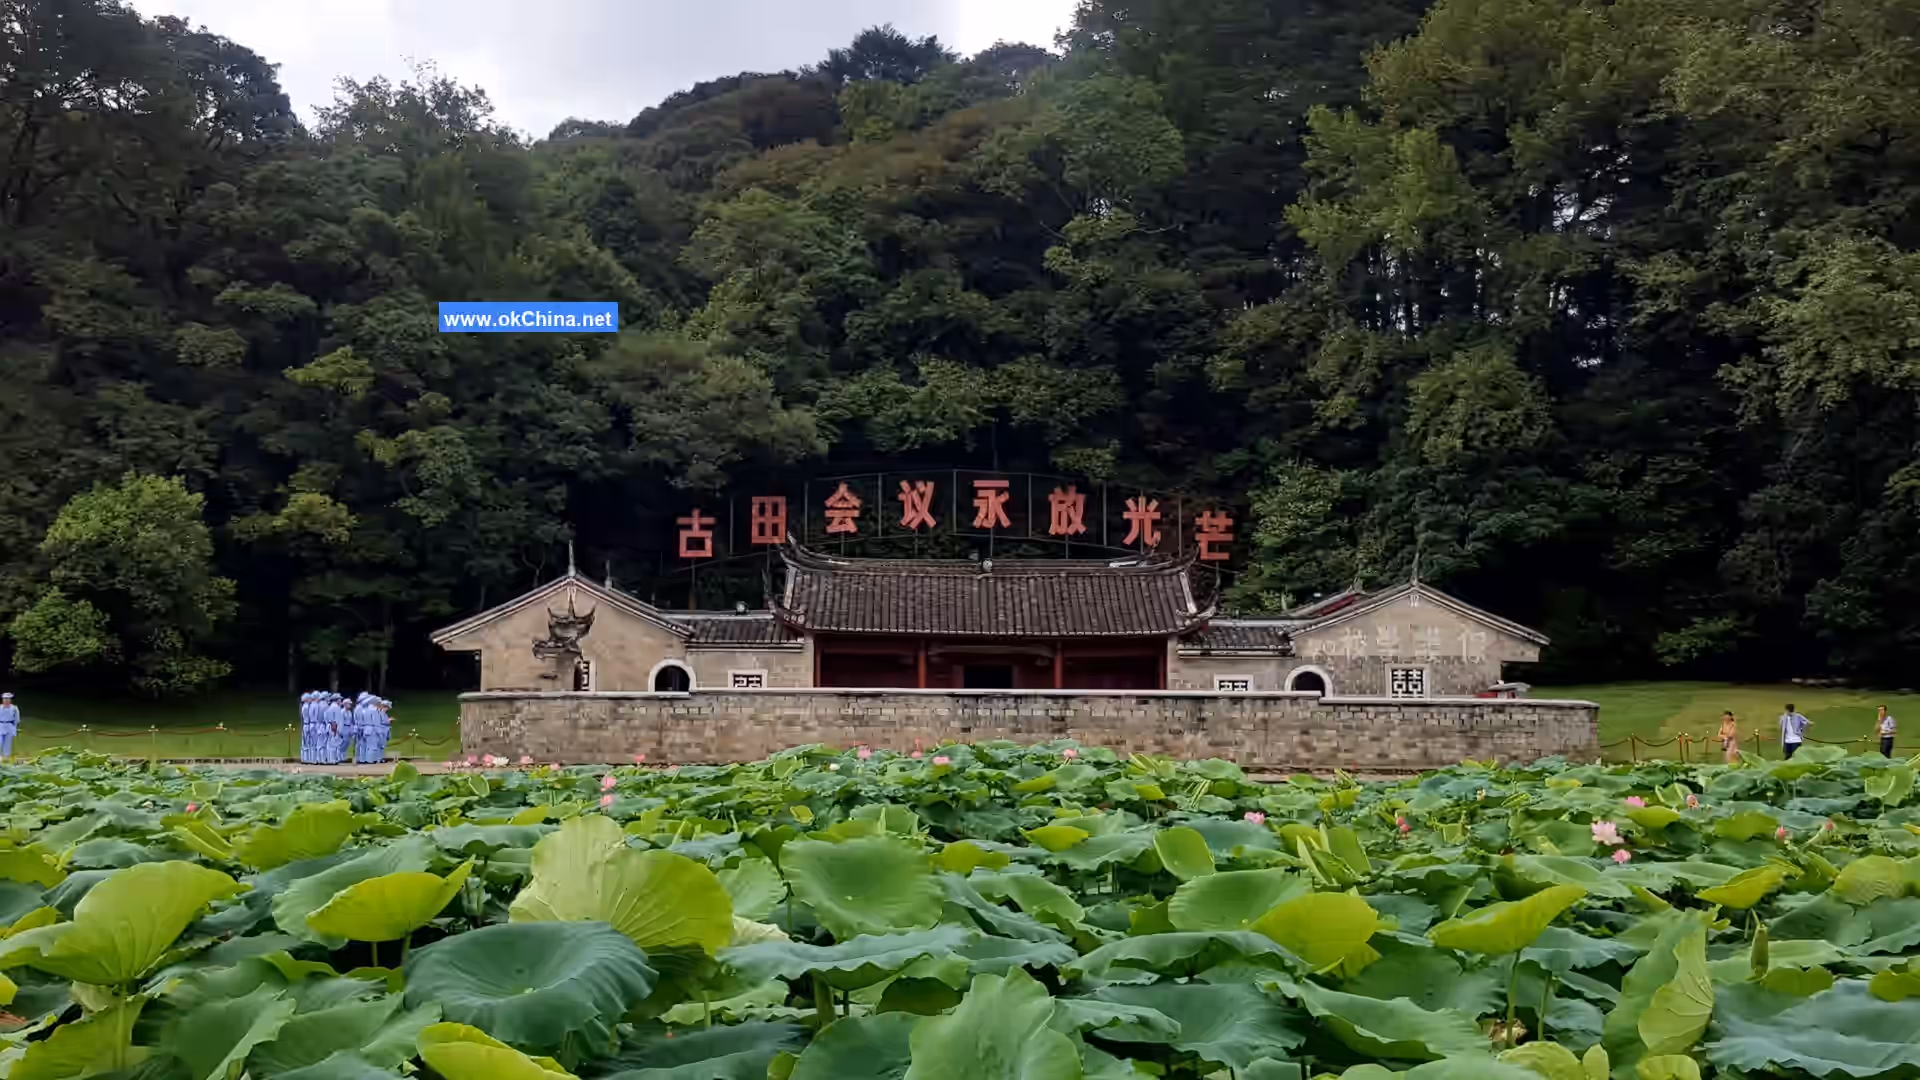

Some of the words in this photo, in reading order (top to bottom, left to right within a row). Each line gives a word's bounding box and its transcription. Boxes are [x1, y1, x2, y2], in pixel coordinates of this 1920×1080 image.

[676, 479, 1234, 560] 古田会议永放光芒
